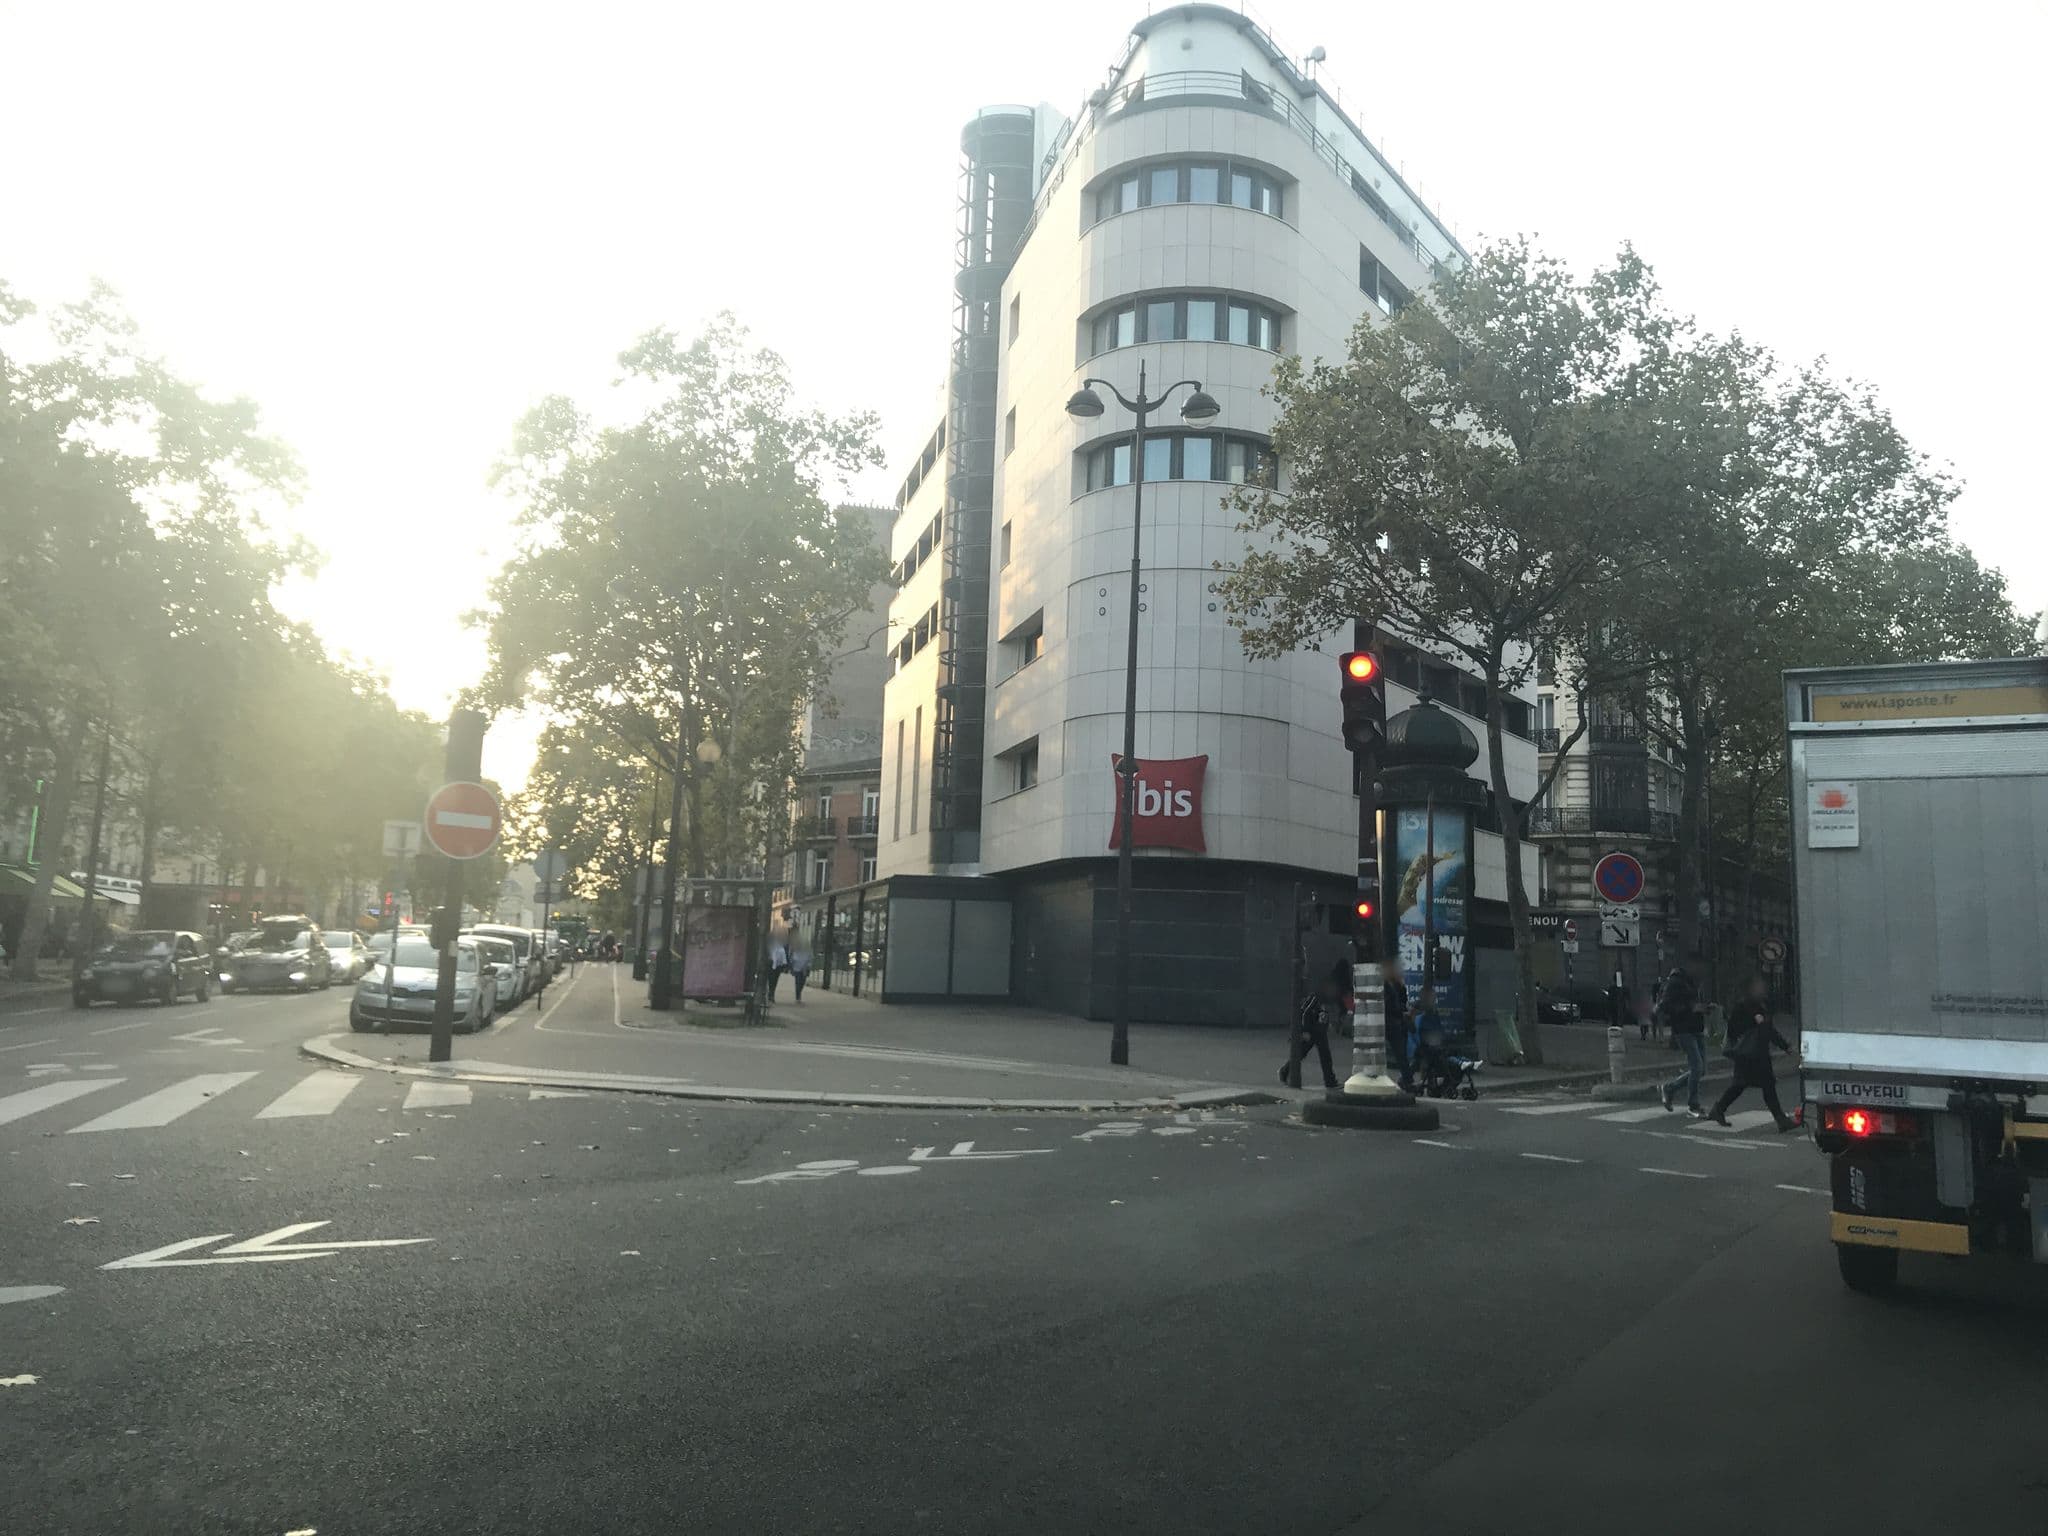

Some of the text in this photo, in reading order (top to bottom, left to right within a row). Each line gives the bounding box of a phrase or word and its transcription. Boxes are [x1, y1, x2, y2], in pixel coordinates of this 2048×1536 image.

[1840, 693, 1958, 710] www.laposte.fr
[1398, 935, 1465, 954] SNW
[1824, 1081, 1905, 1100] LALOYEAU
